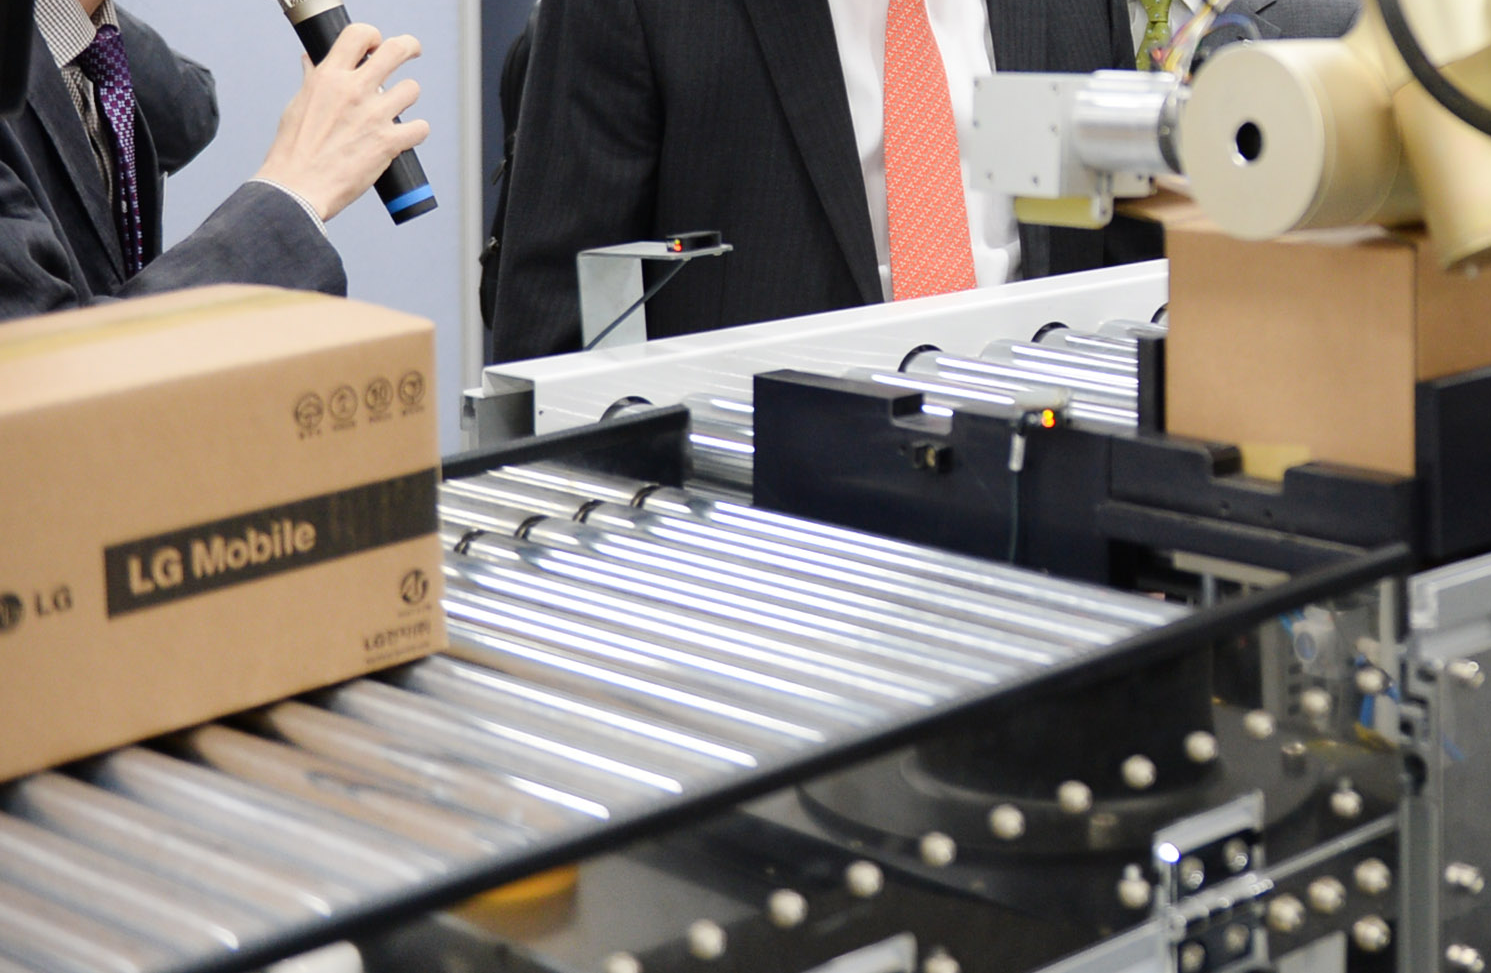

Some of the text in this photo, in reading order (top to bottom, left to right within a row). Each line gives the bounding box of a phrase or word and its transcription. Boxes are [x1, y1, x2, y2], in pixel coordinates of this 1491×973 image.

[128, 518, 316, 596] LG Mobile
[34, 585, 73, 616] LG
